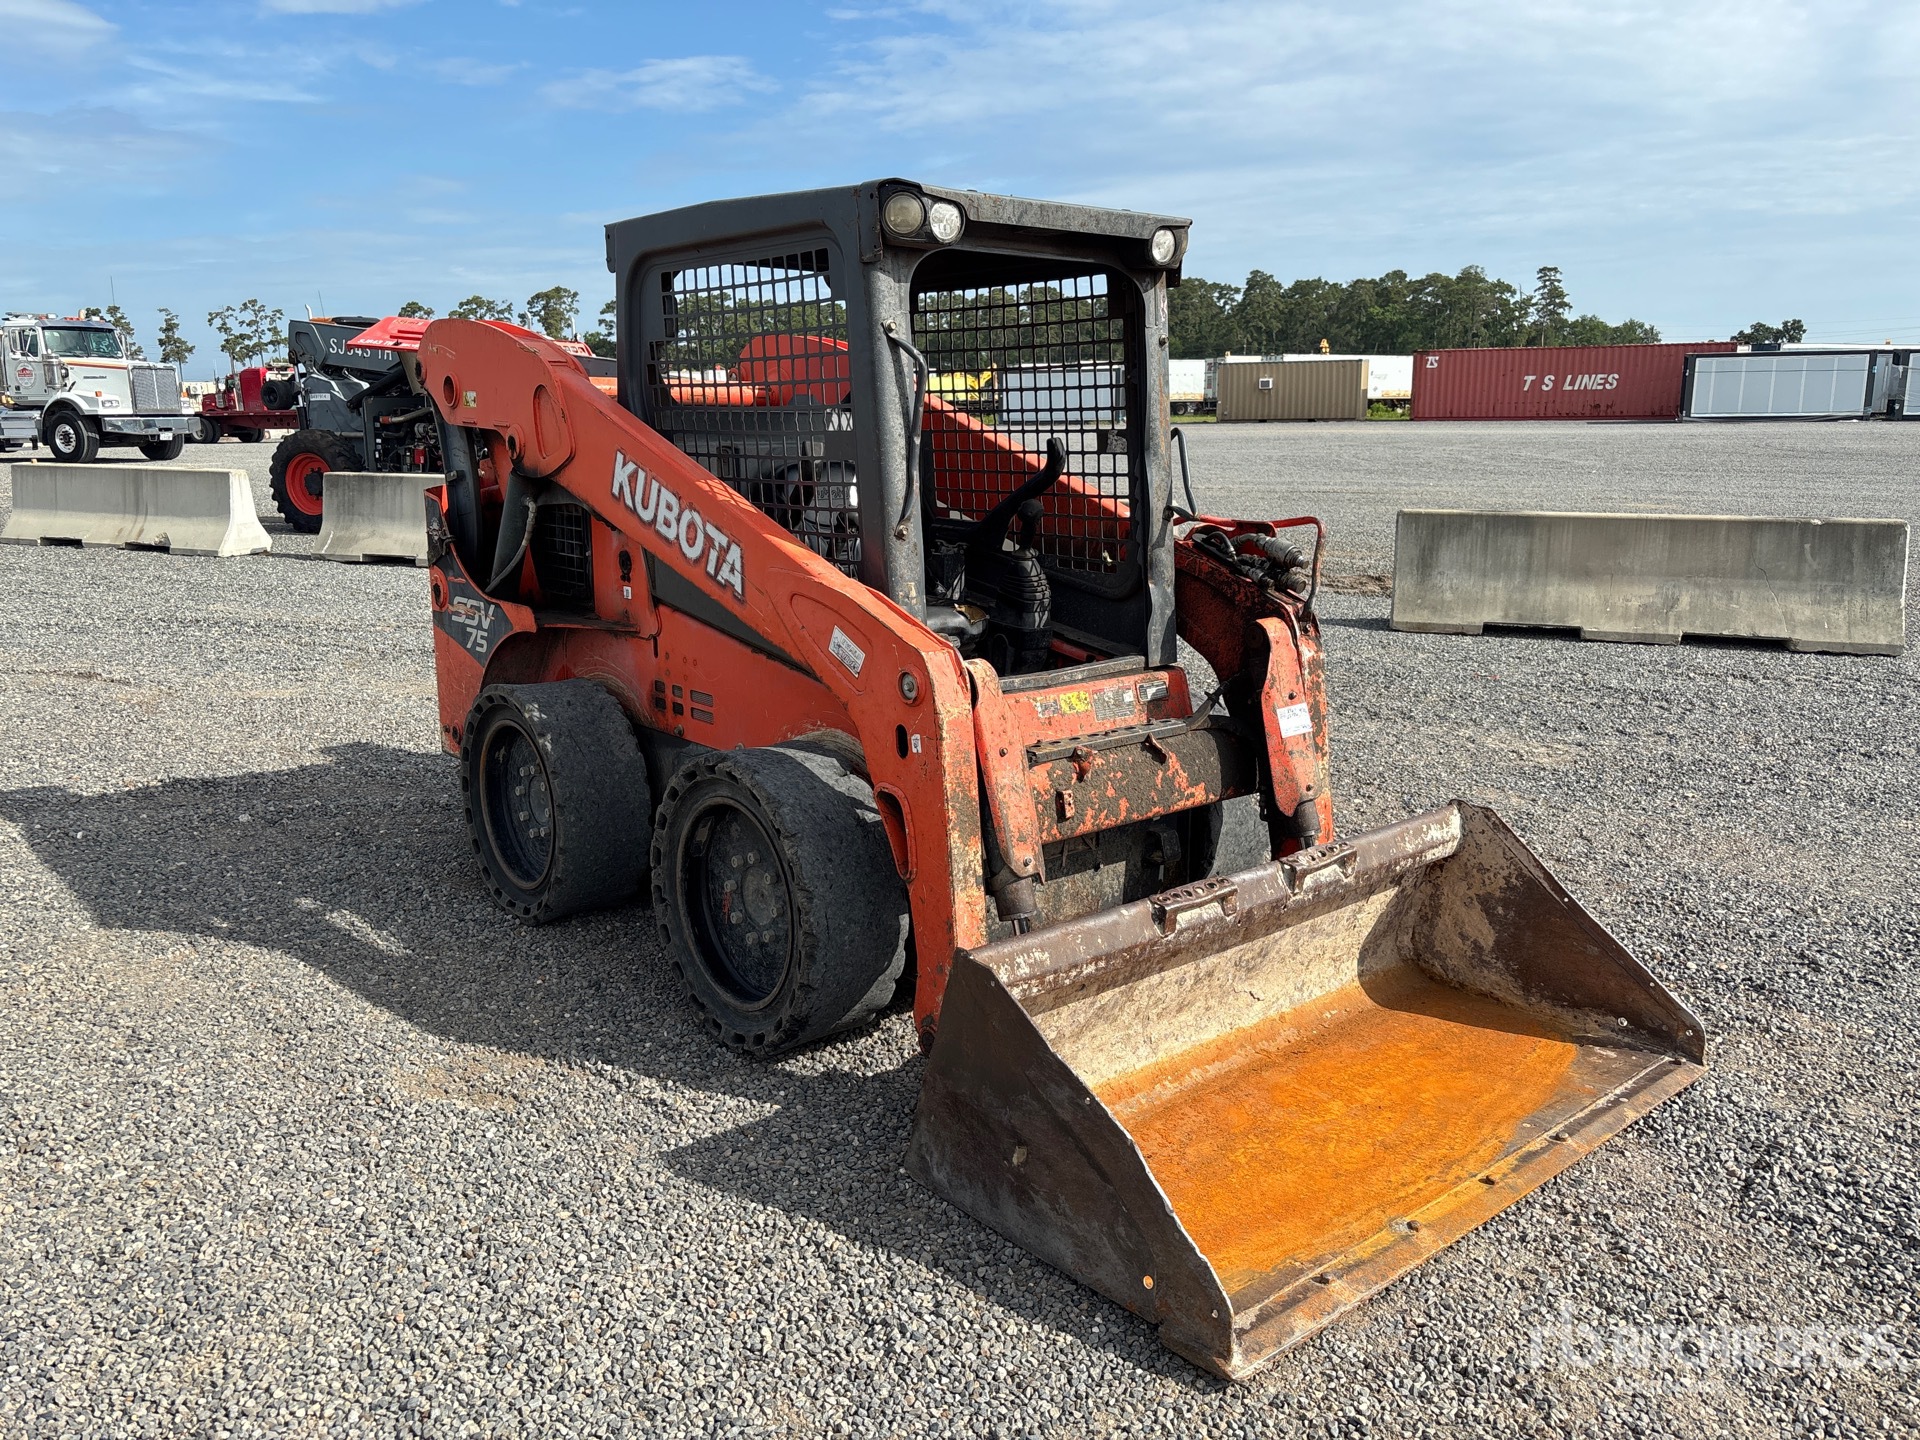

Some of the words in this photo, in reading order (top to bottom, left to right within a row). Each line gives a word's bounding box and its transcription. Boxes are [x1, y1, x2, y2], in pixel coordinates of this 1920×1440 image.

[1523, 375, 1536, 391] T
[1541, 374, 1555, 391] S
[1562, 373, 1620, 391] LINES
[611, 450, 744, 600] KUBOTA
[451, 595, 496, 630] SSV
[466, 626, 489, 653] 75
